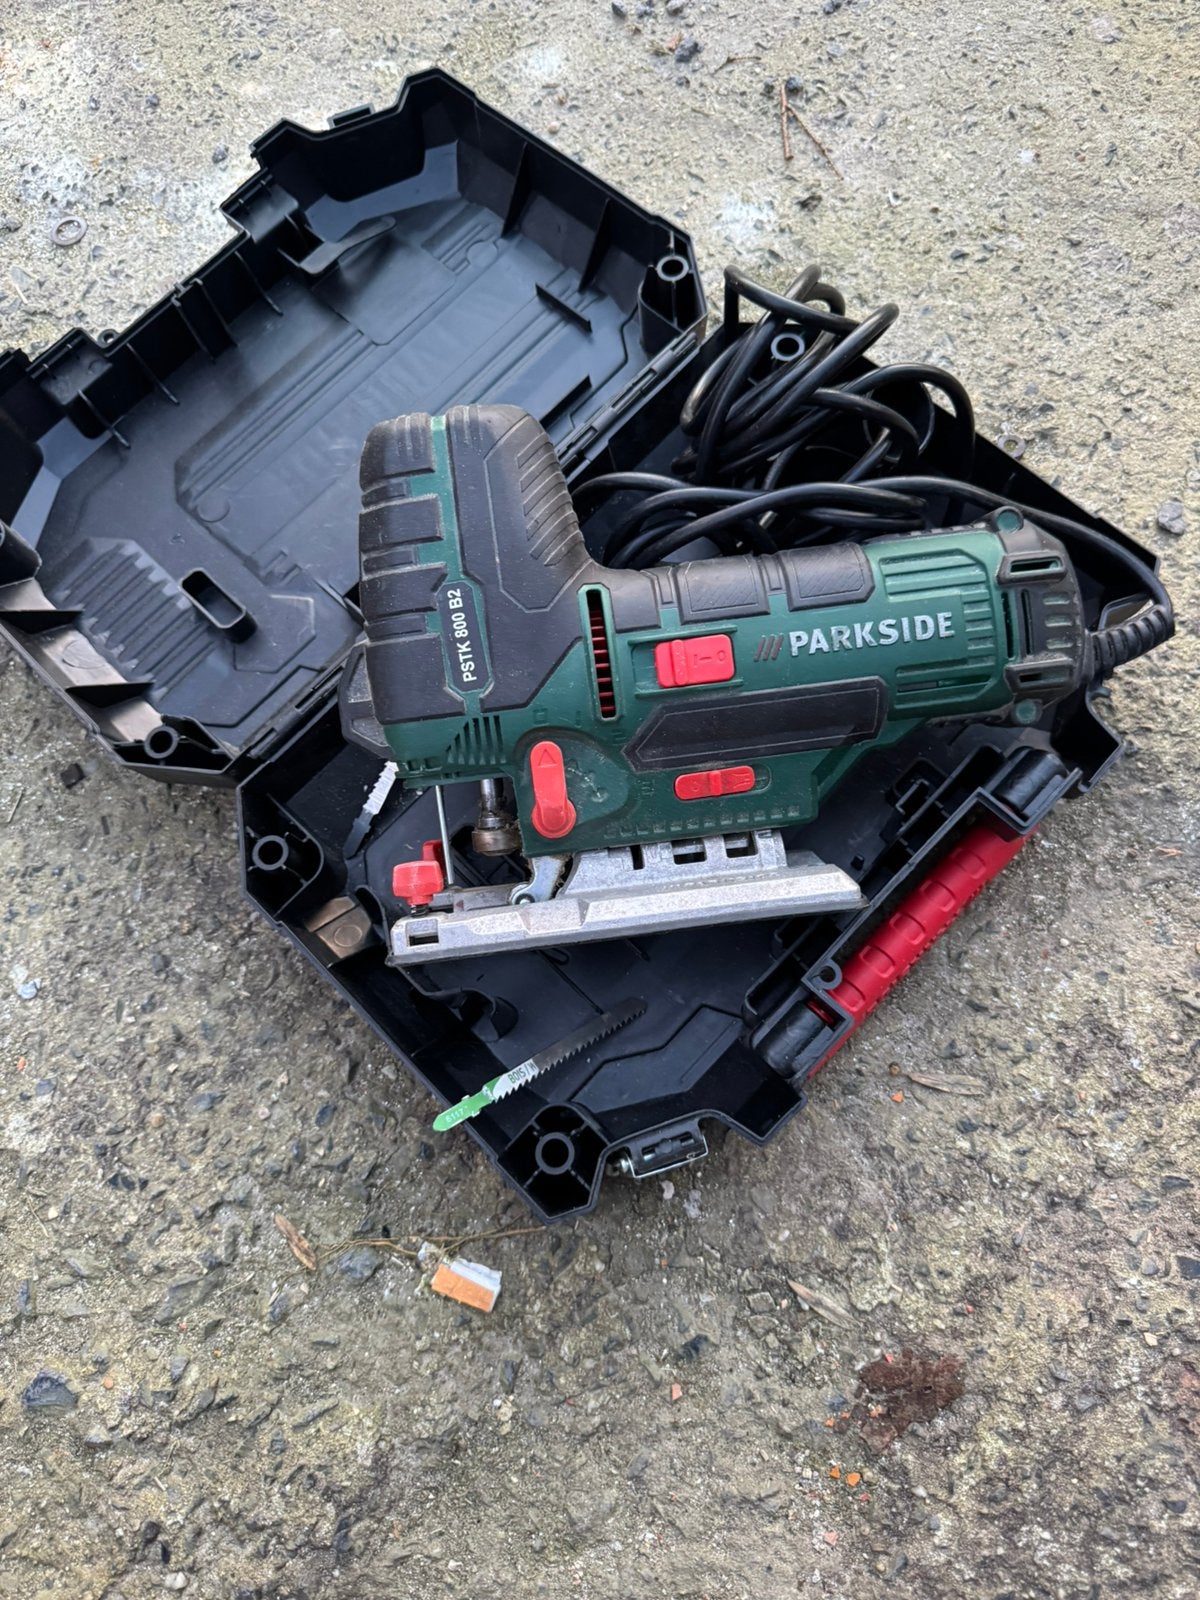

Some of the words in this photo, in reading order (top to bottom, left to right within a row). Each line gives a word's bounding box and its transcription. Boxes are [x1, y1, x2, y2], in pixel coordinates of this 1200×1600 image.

[447, 588, 463, 610] B2
[451, 612, 469, 639] 800
[788, 611, 956, 658] PARKSIDE
[456, 640, 477, 682] PSTK
